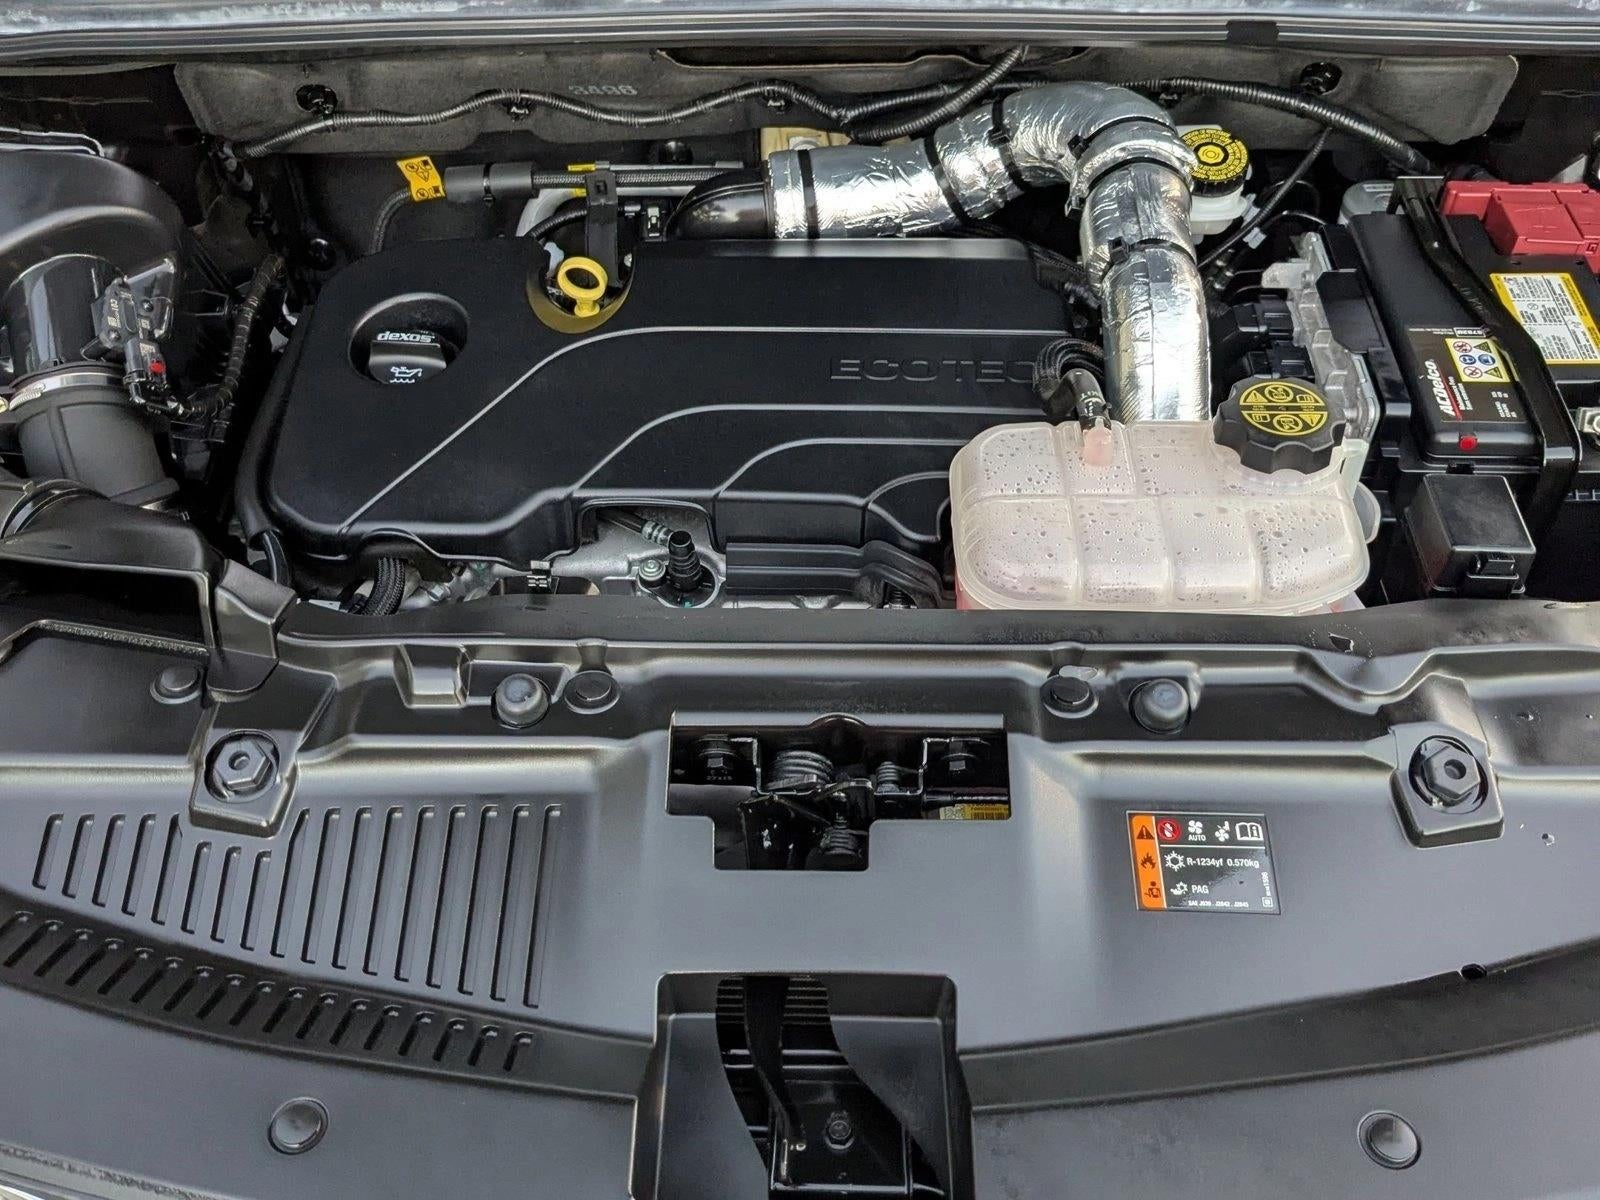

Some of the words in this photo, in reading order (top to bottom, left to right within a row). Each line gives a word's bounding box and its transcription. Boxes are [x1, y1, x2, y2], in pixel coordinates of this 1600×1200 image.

[377, 331, 435, 343] dexos
[1424, 359, 1456, 416] ACDelco
[1188, 834, 1206, 842] AUTO
[1186, 858, 1223, 867] R-1234yf
[1227, 858, 1260, 869] 0.570kg
[1191, 884, 1209, 894] PAG
